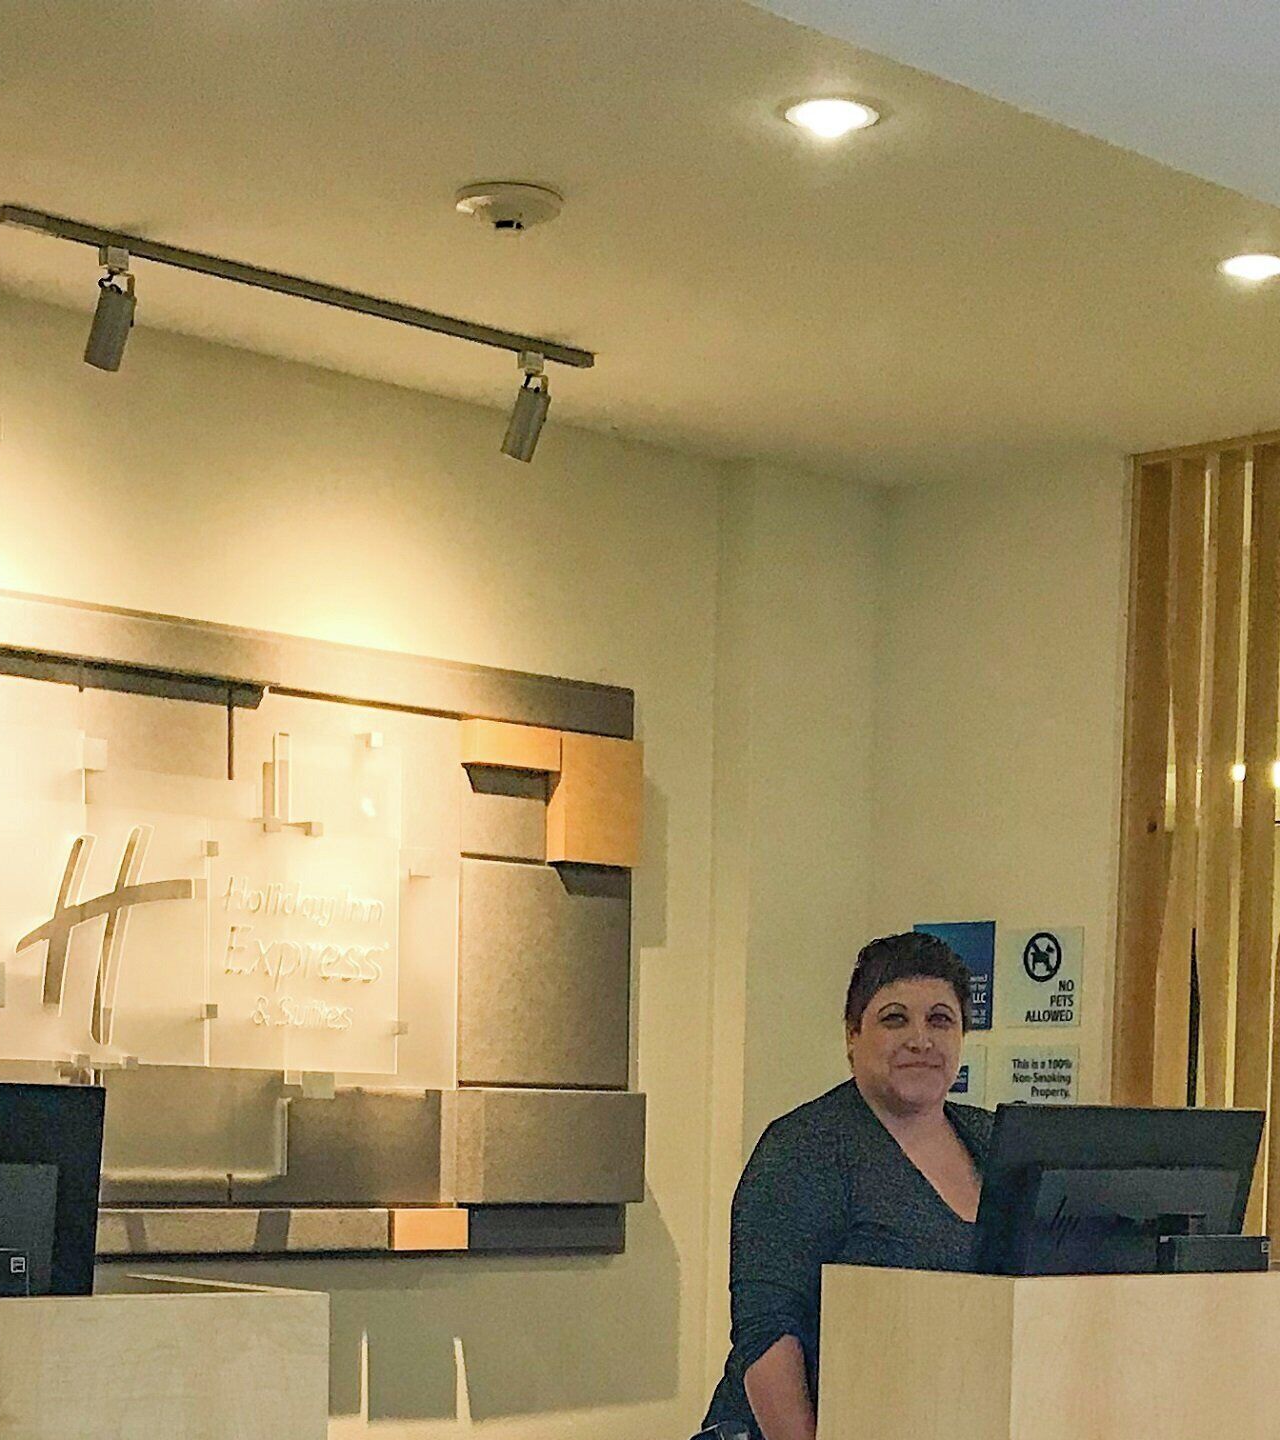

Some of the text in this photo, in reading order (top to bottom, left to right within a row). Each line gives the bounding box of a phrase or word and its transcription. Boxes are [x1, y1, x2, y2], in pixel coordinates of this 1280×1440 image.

[223, 876, 385, 927] Holiday Inn
[224, 926, 383, 992] Express
[1058, 980, 1074, 992] NO
[1050, 995, 1074, 1007] PETS
[251, 995, 354, 1031] & Suites
[1025, 1010, 1073, 1022] ALLOWED
[1011, 1058, 1029, 1069] This
[1031, 1059, 1039, 1069] is
[1048, 1058, 1072, 1069] 100%
[1012, 1072, 1072, 1085] Non-Smoking
